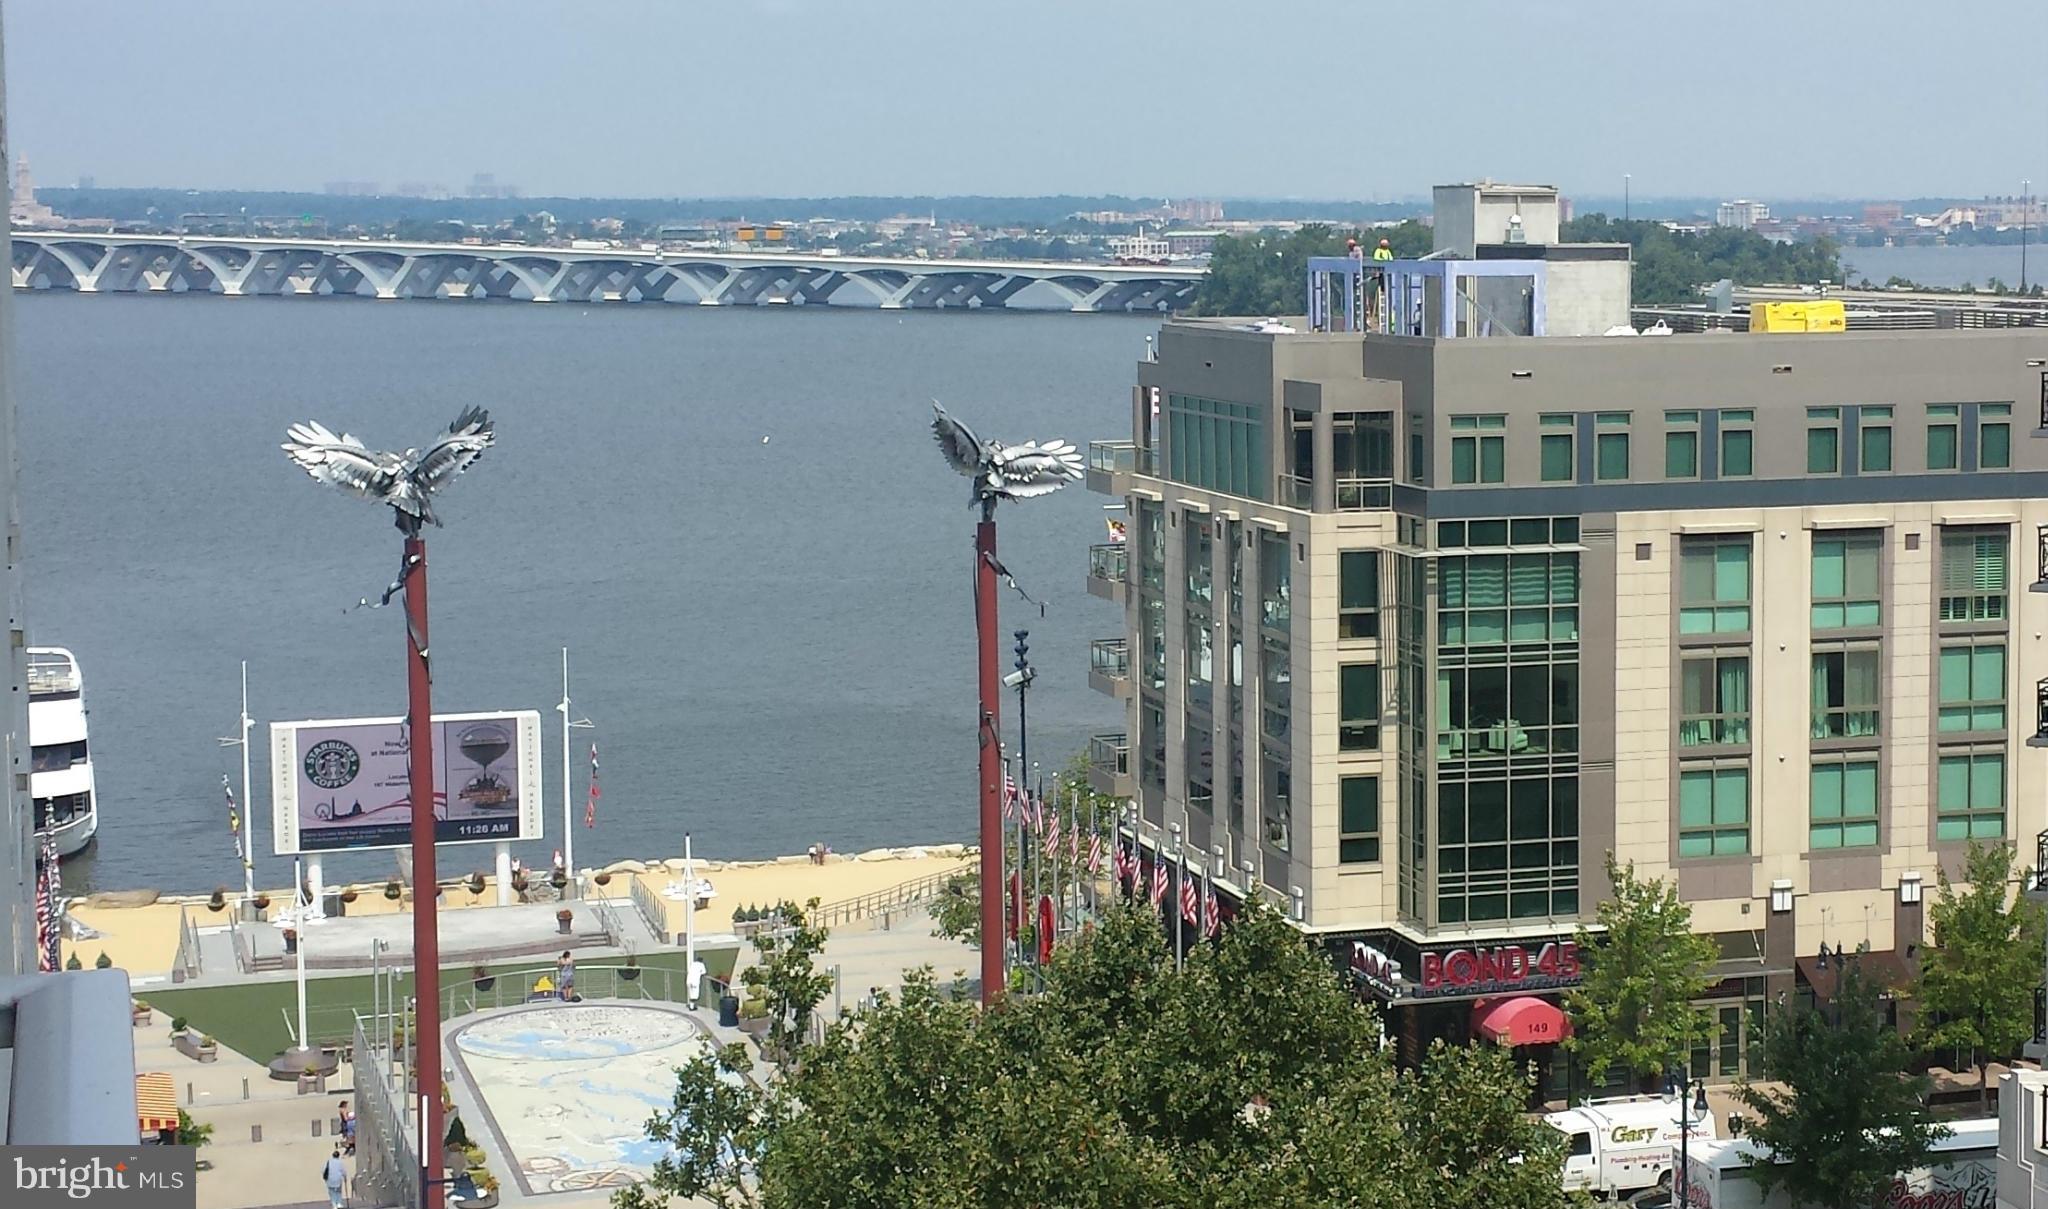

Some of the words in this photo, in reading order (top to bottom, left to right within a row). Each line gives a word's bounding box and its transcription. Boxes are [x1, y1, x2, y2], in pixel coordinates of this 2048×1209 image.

[306, 742, 358, 765] STARBUCKS
[313, 775, 353, 788] COFFEE
[492, 823, 509, 833] AM
[1420, 945, 1530, 988] BOND
[1537, 940, 1581, 977] 45
[1528, 1022, 1548, 1034] 149
[1611, 1126, 1658, 1143] Gary
